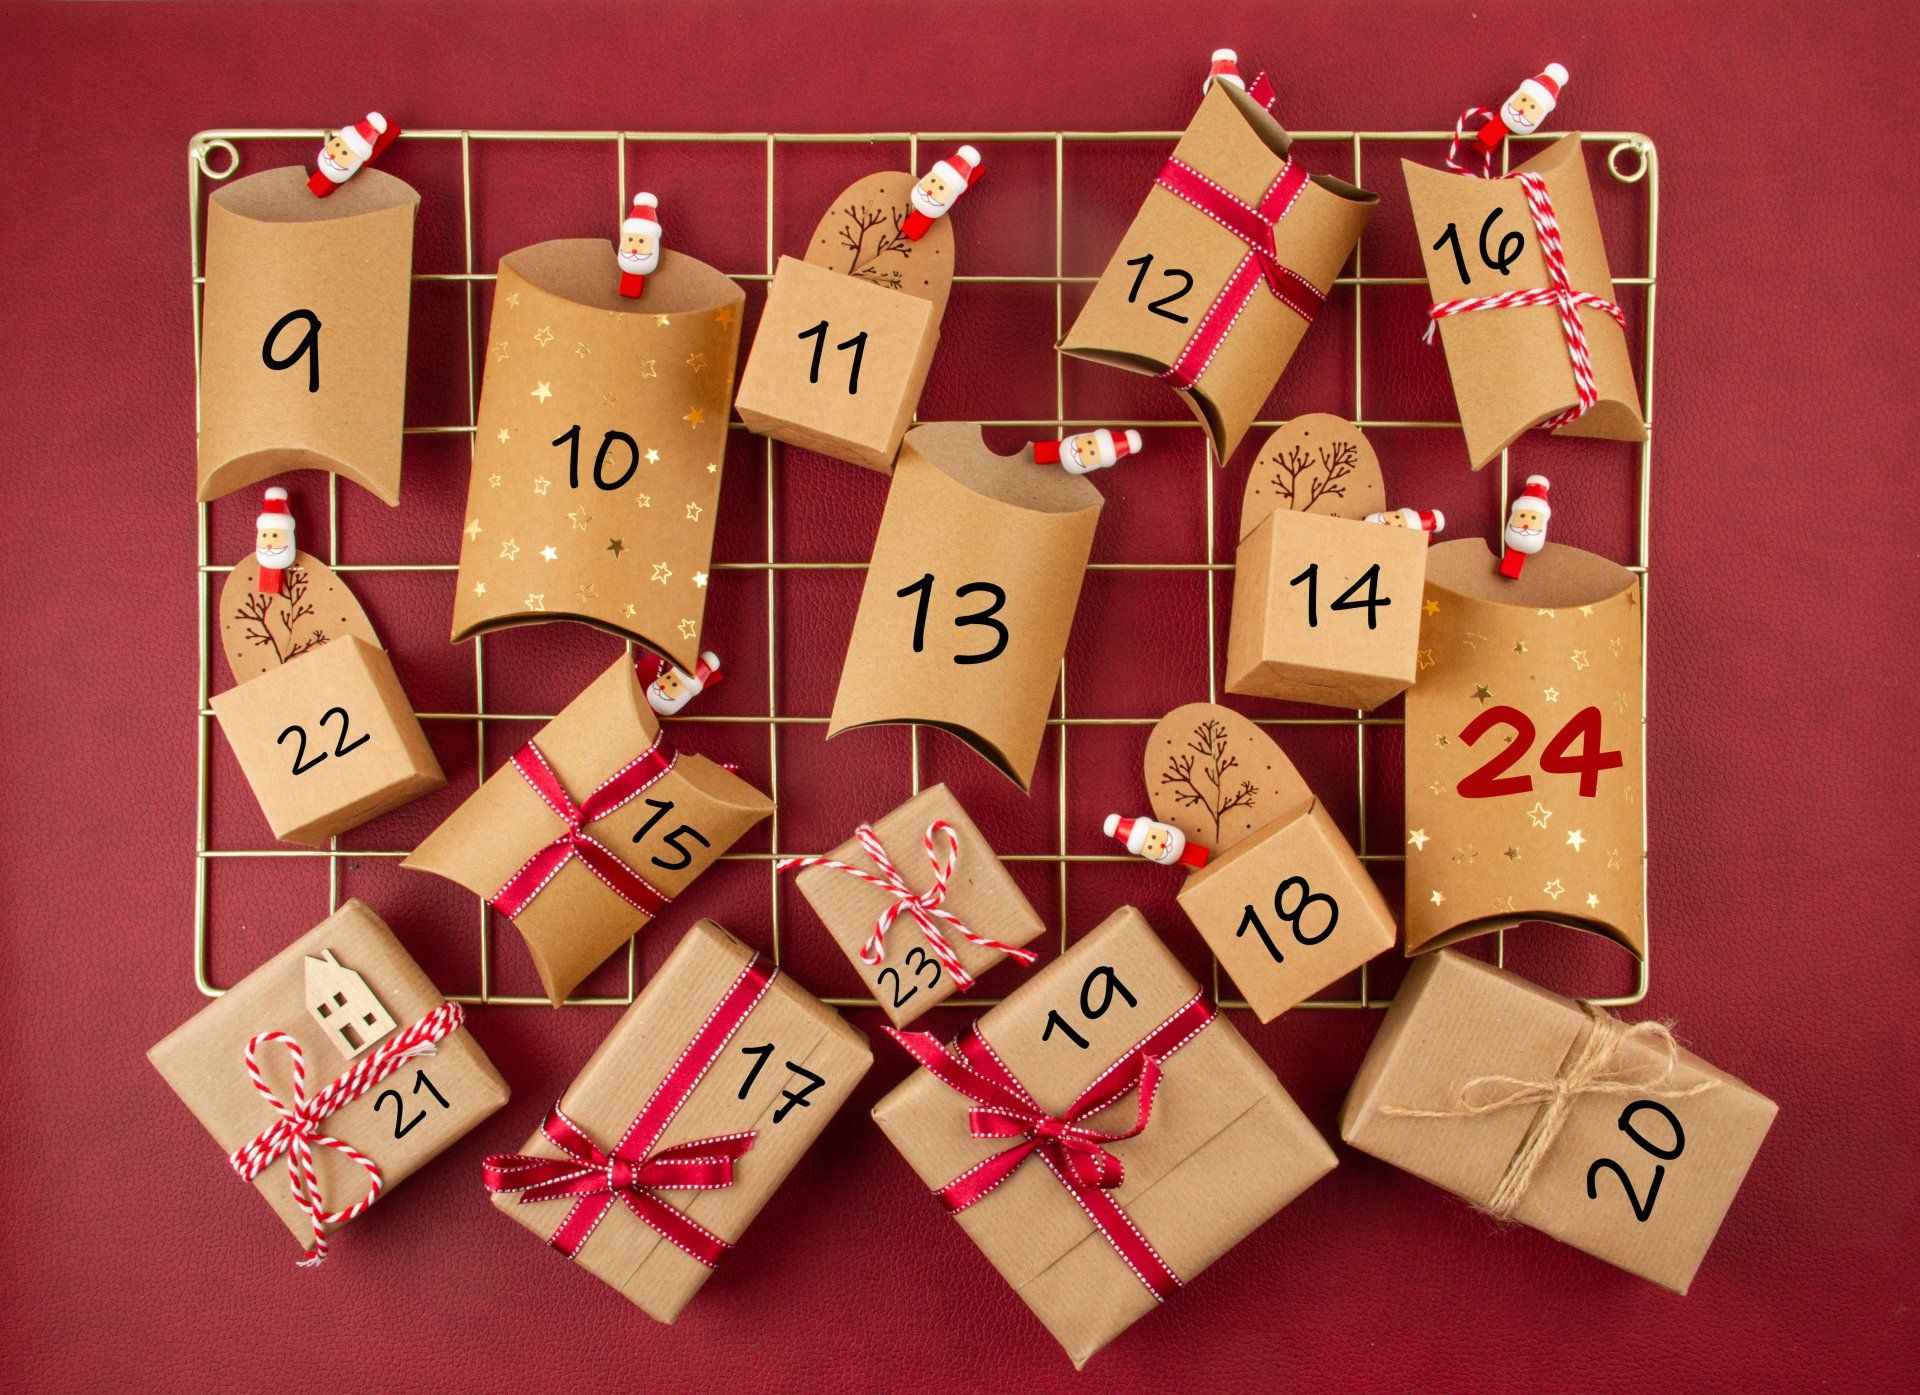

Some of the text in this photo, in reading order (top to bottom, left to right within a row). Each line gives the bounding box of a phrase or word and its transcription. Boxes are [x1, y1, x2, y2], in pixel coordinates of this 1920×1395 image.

[1432, 207, 1525, 285] 16
[1126, 253, 1194, 324] 12
[262, 308, 322, 393] 9
[798, 320, 868, 395] 11
[551, 424, 640, 491] 10
[896, 573, 1009, 665] 13
[1289, 563, 1392, 630] 14
[277, 706, 371, 776] 22
[1456, 705, 1623, 799] 24
[632, 798, 711, 871] 15
[1236, 875, 1339, 964] 18
[877, 946, 942, 1008] 23
[1041, 965, 1138, 1050] 19
[373, 1069, 450, 1140] 21
[737, 1042, 826, 1124] 17
[1586, 1099, 1686, 1223] 20
